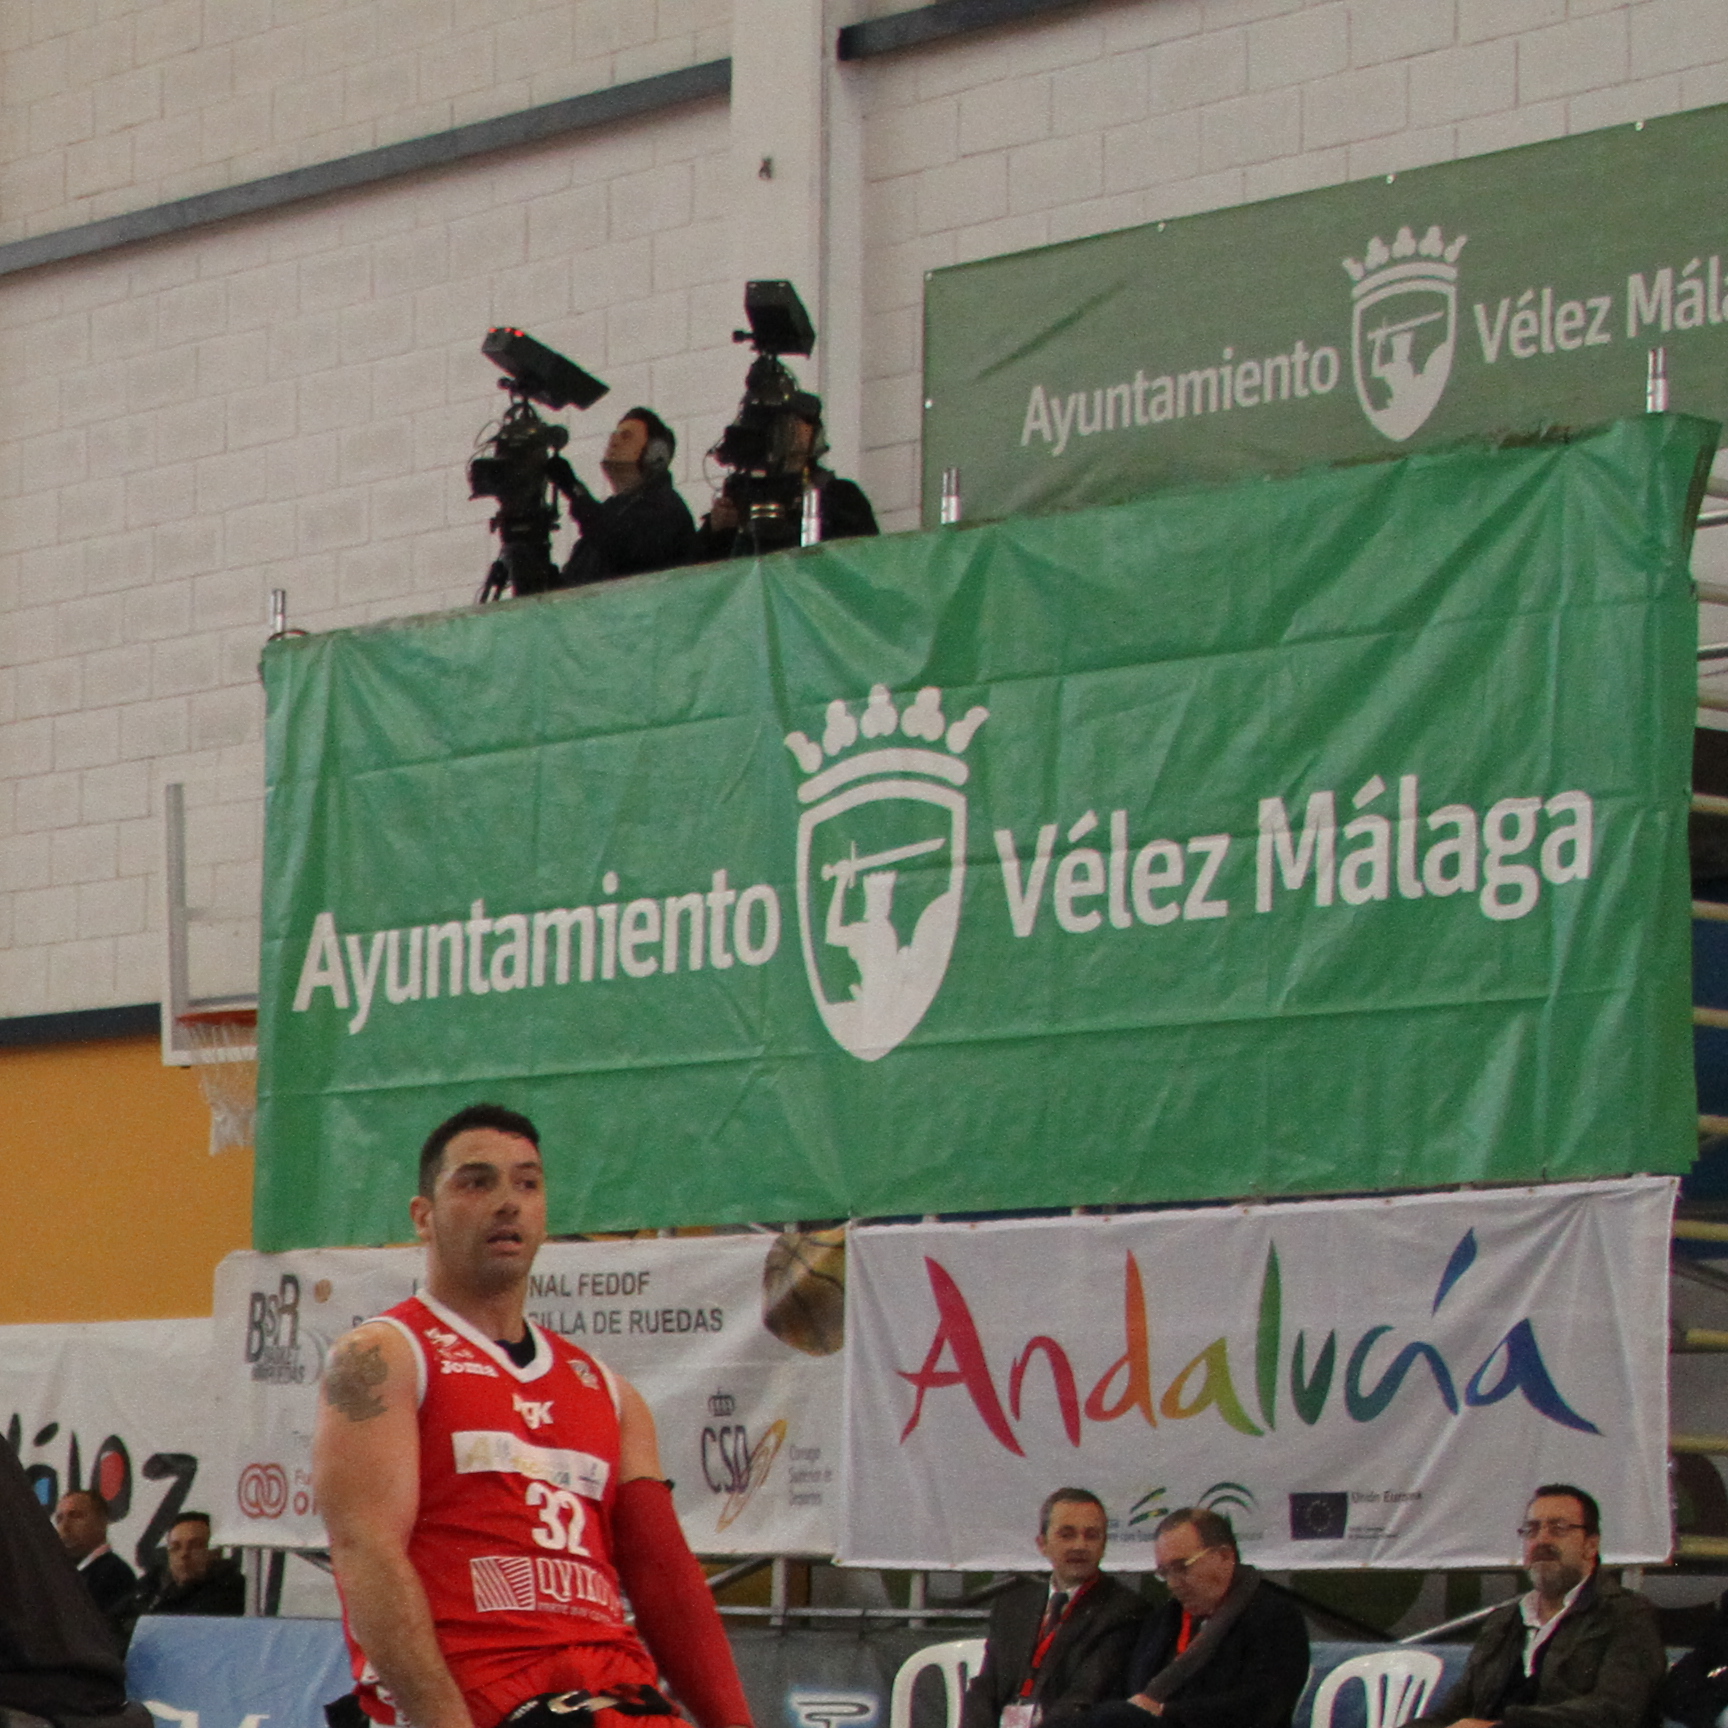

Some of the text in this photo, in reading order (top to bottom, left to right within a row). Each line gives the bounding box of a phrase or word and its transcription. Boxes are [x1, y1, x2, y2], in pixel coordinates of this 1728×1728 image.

[1019, 253, 1728, 457] Ayuntamiento Vélez Mál
[292, 774, 1595, 1036] Ayuntamiento Vélez Málaga
[593, 1310, 622, 1335] DE
[629, 1307, 723, 1333] RUEDAS
[897, 1226, 1605, 1458] Andalucía
[525, 1481, 591, 1557] 32
